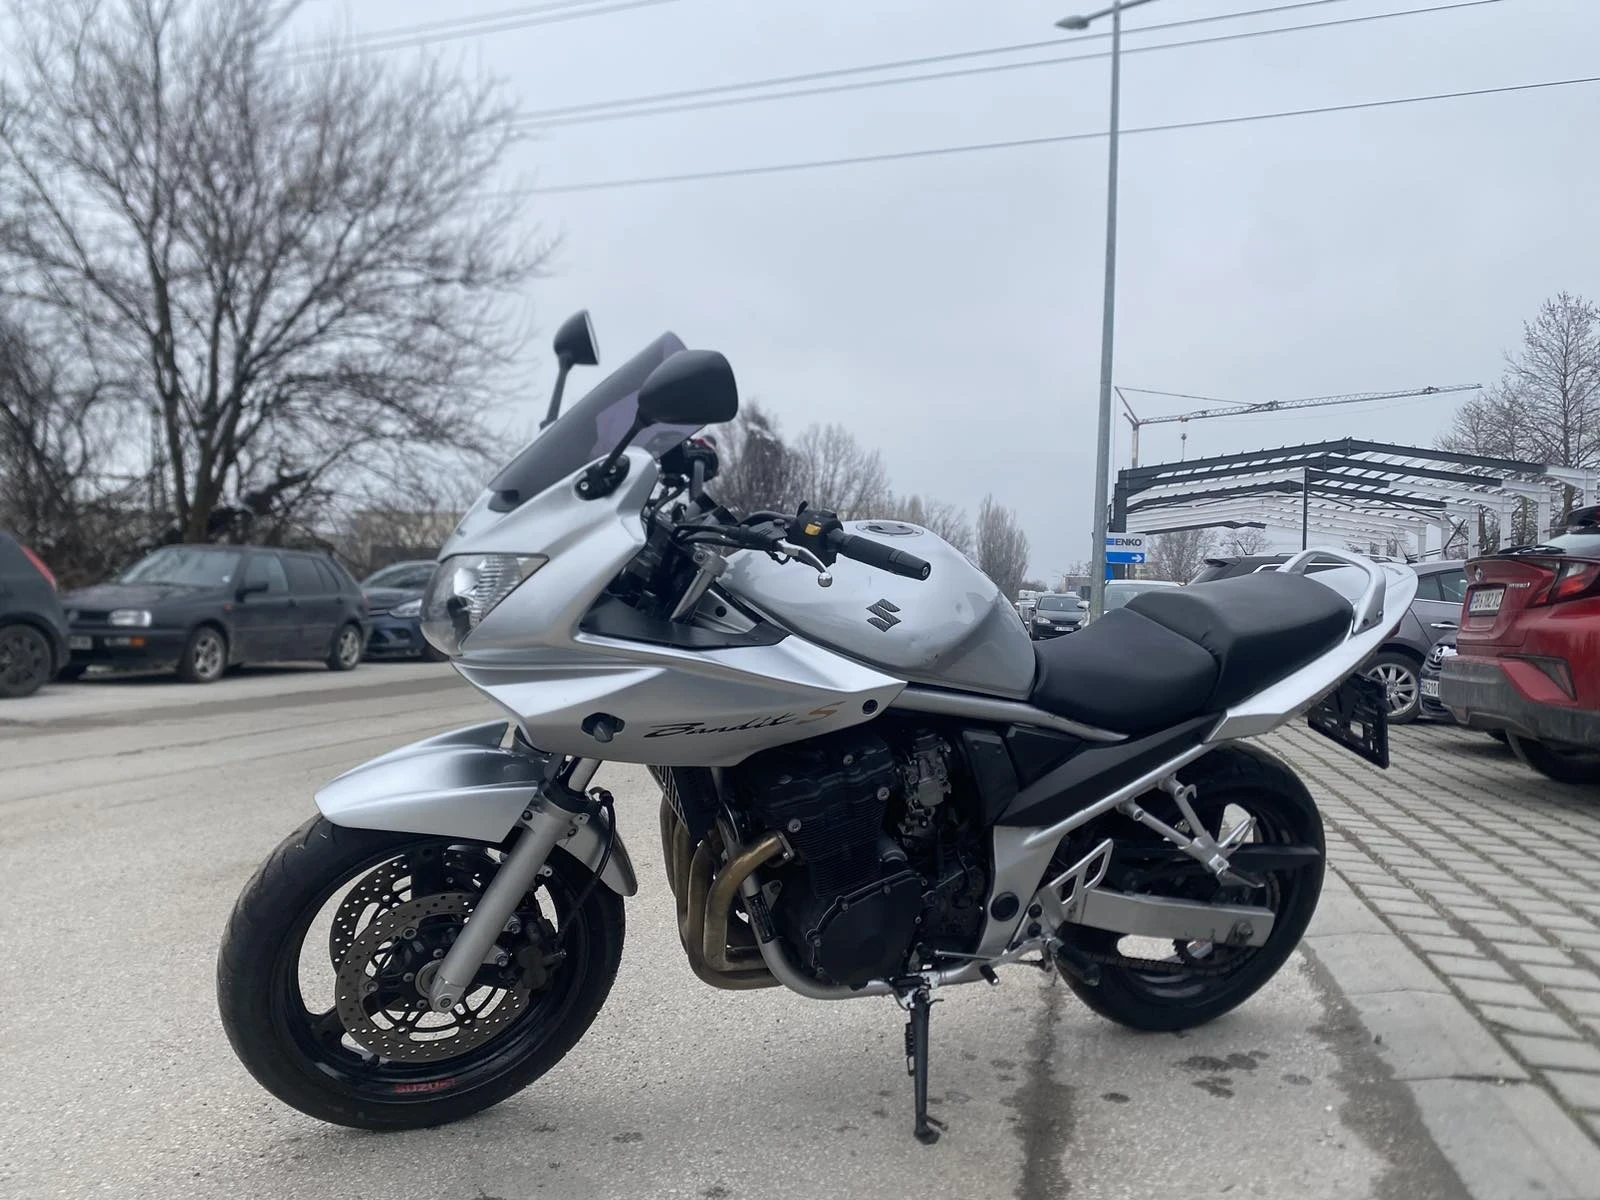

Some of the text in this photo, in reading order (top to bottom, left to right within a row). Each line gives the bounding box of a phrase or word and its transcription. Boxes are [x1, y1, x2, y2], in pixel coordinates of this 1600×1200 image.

[1115, 538, 1142, 546] ENKO
[643, 700, 847, 738] Bandit S
